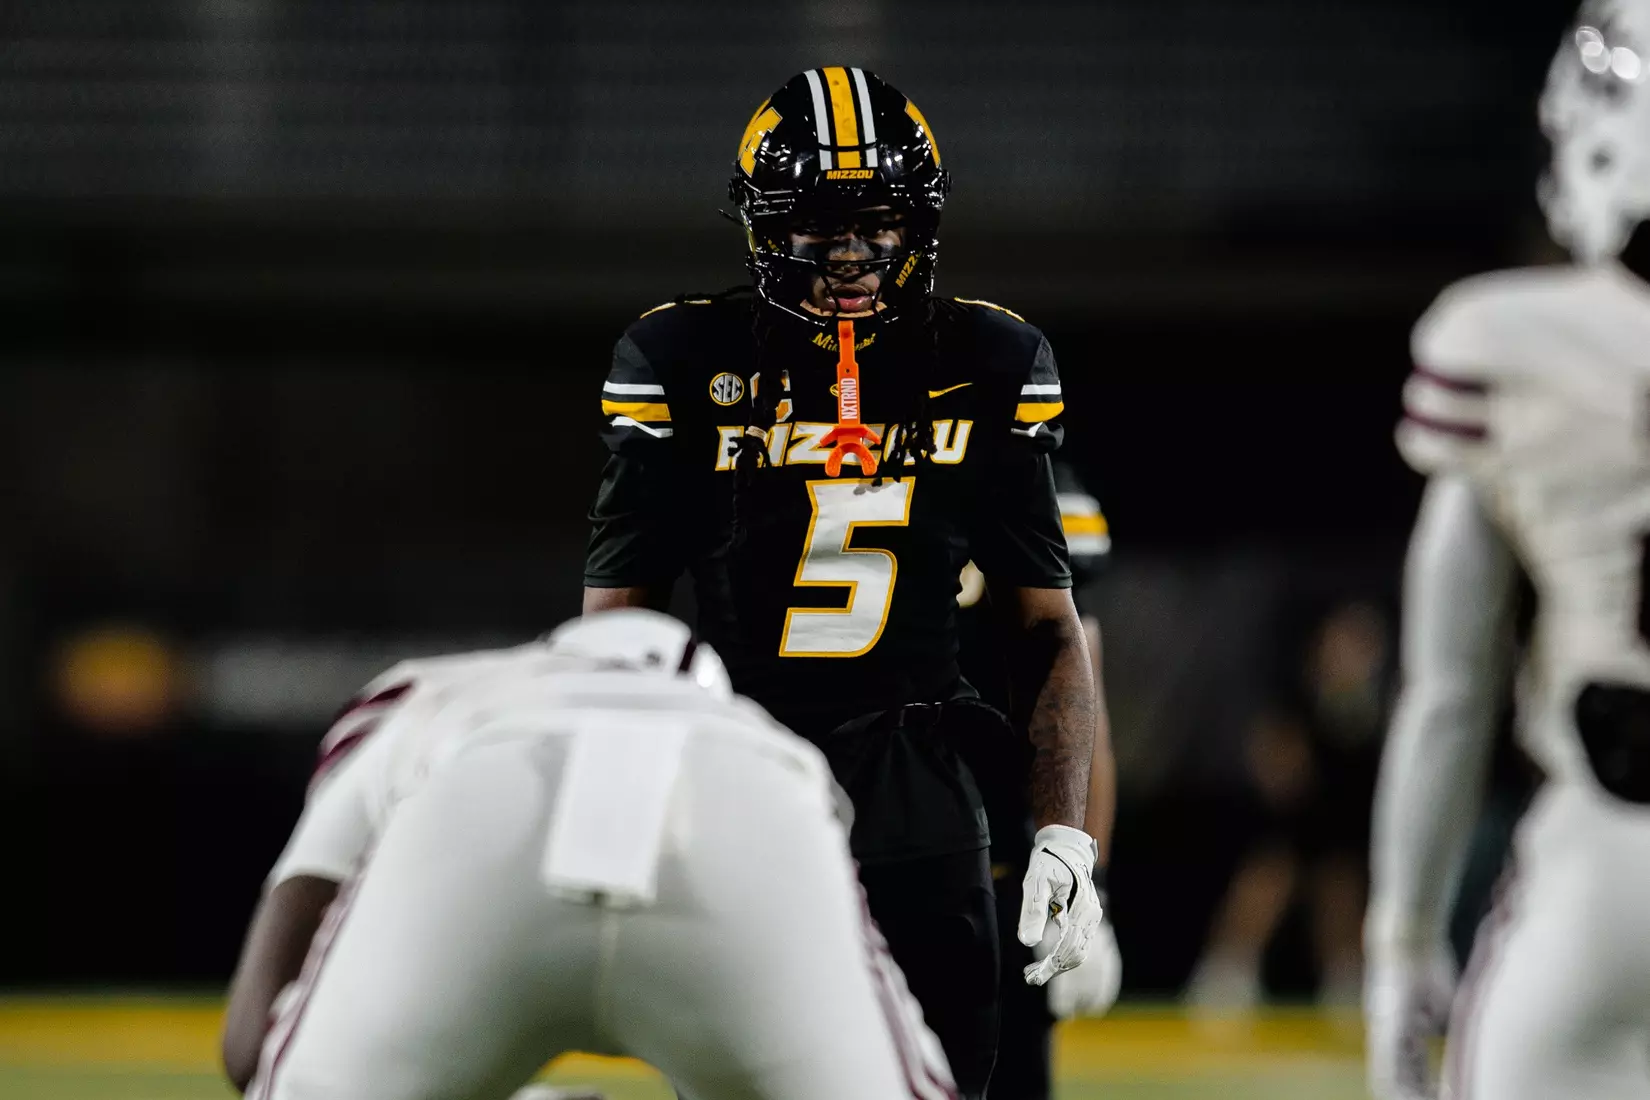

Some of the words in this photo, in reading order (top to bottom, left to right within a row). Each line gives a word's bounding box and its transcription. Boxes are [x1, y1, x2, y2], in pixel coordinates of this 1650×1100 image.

[826, 169, 874, 180] MIZZOU
[713, 375, 741, 403] SEC
[840, 377, 858, 420] NXTRND
[778, 476, 916, 658] 5
